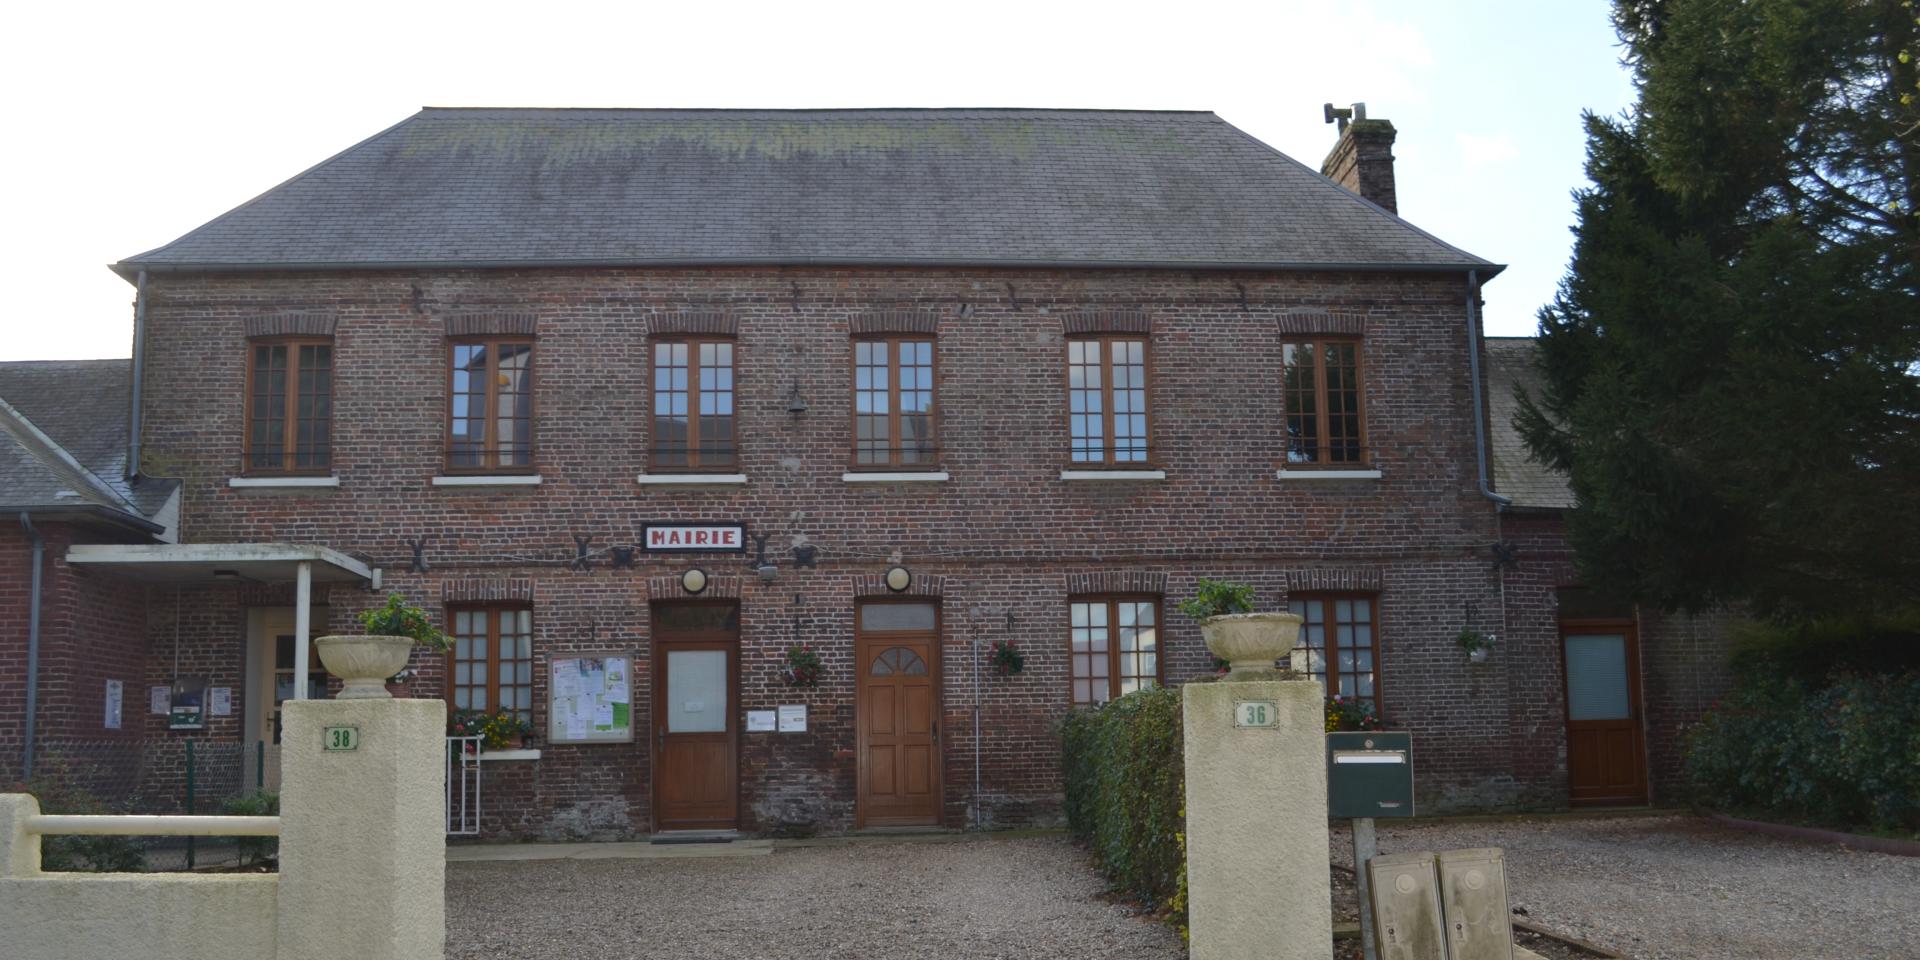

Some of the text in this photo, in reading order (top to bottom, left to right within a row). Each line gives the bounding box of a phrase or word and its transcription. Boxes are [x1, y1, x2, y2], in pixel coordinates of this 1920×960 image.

[652, 530, 735, 545] MAIRIE
[1247, 705, 1265, 724] 36
[333, 730, 350, 747] 38
